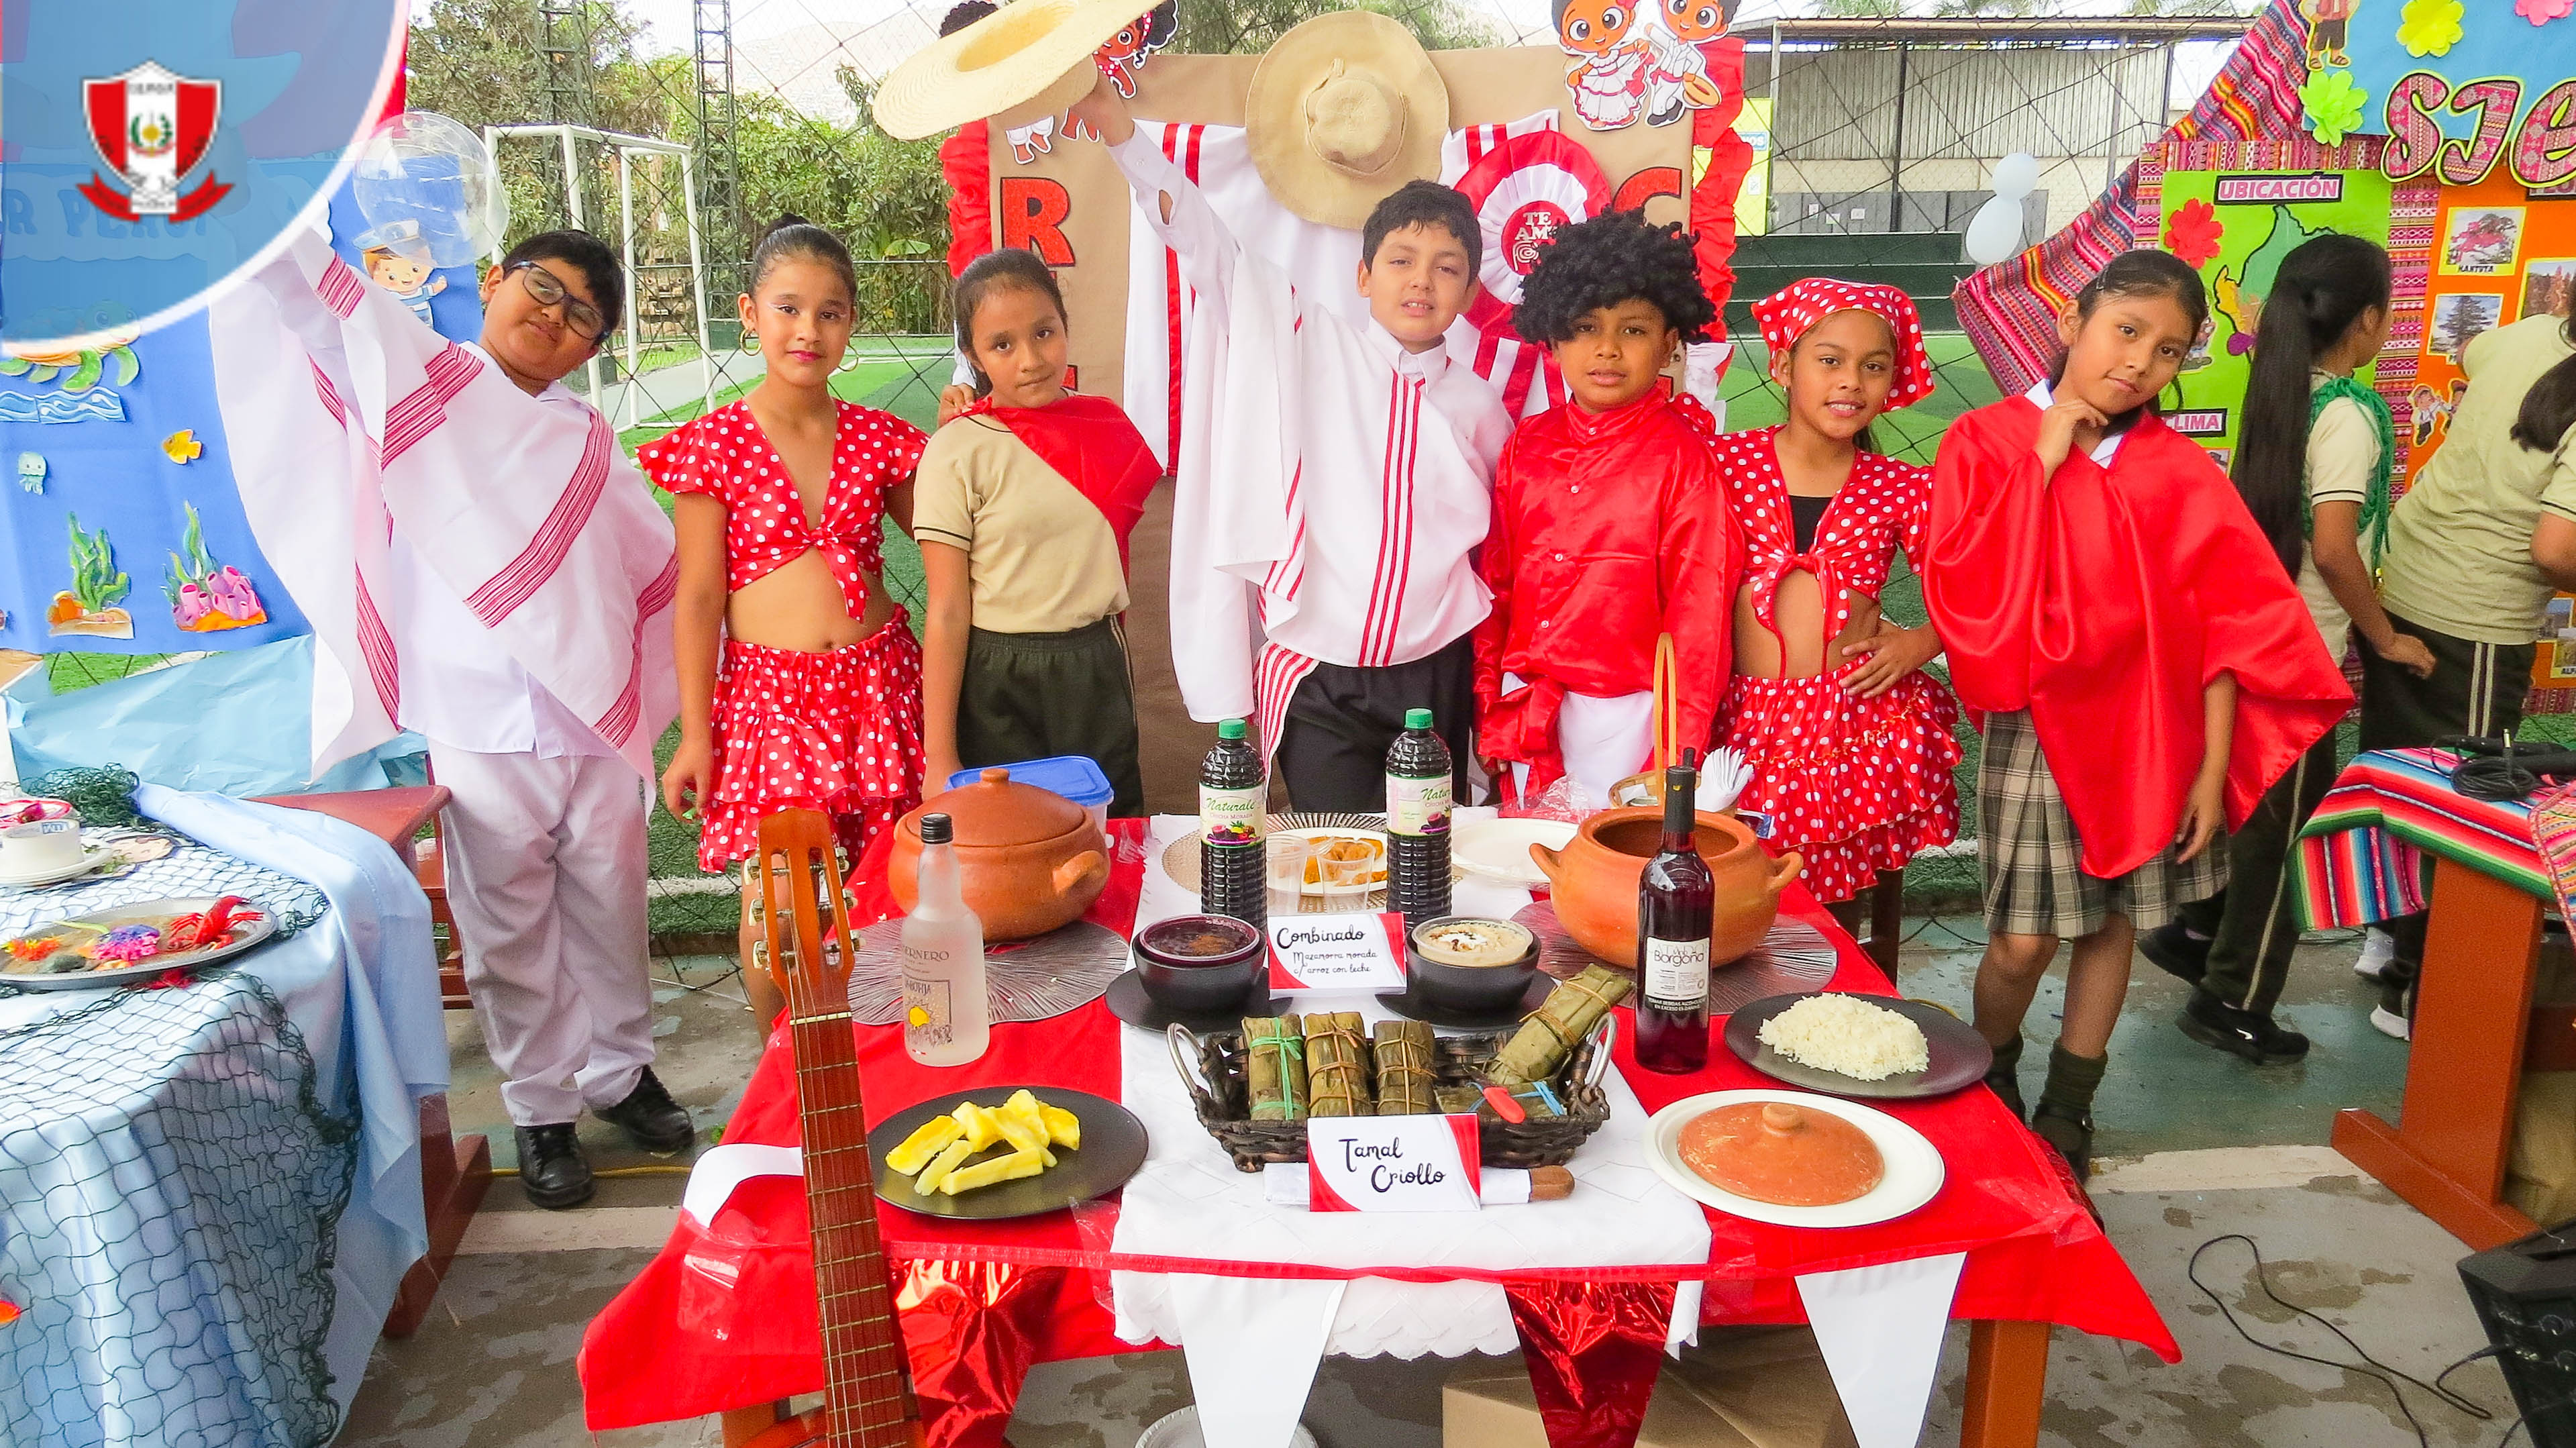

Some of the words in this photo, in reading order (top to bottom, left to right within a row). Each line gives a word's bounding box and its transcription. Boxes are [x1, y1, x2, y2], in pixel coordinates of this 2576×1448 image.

[2219, 176, 2337, 199] UBICACIÓN
[1523, 211, 1551, 225] TE
[2166, 415, 2220, 430] LIMA
[1277, 924, 1366, 949] Combinado
[903, 945, 949, 962] ERNERO
[1346, 948, 1378, 960] morada
[1654, 950, 1704, 967] Borgoña
[1349, 963, 1371, 973] leche
[1338, 1137, 1404, 1172] Tamal
[1371, 1163, 1447, 1193] Criollo
